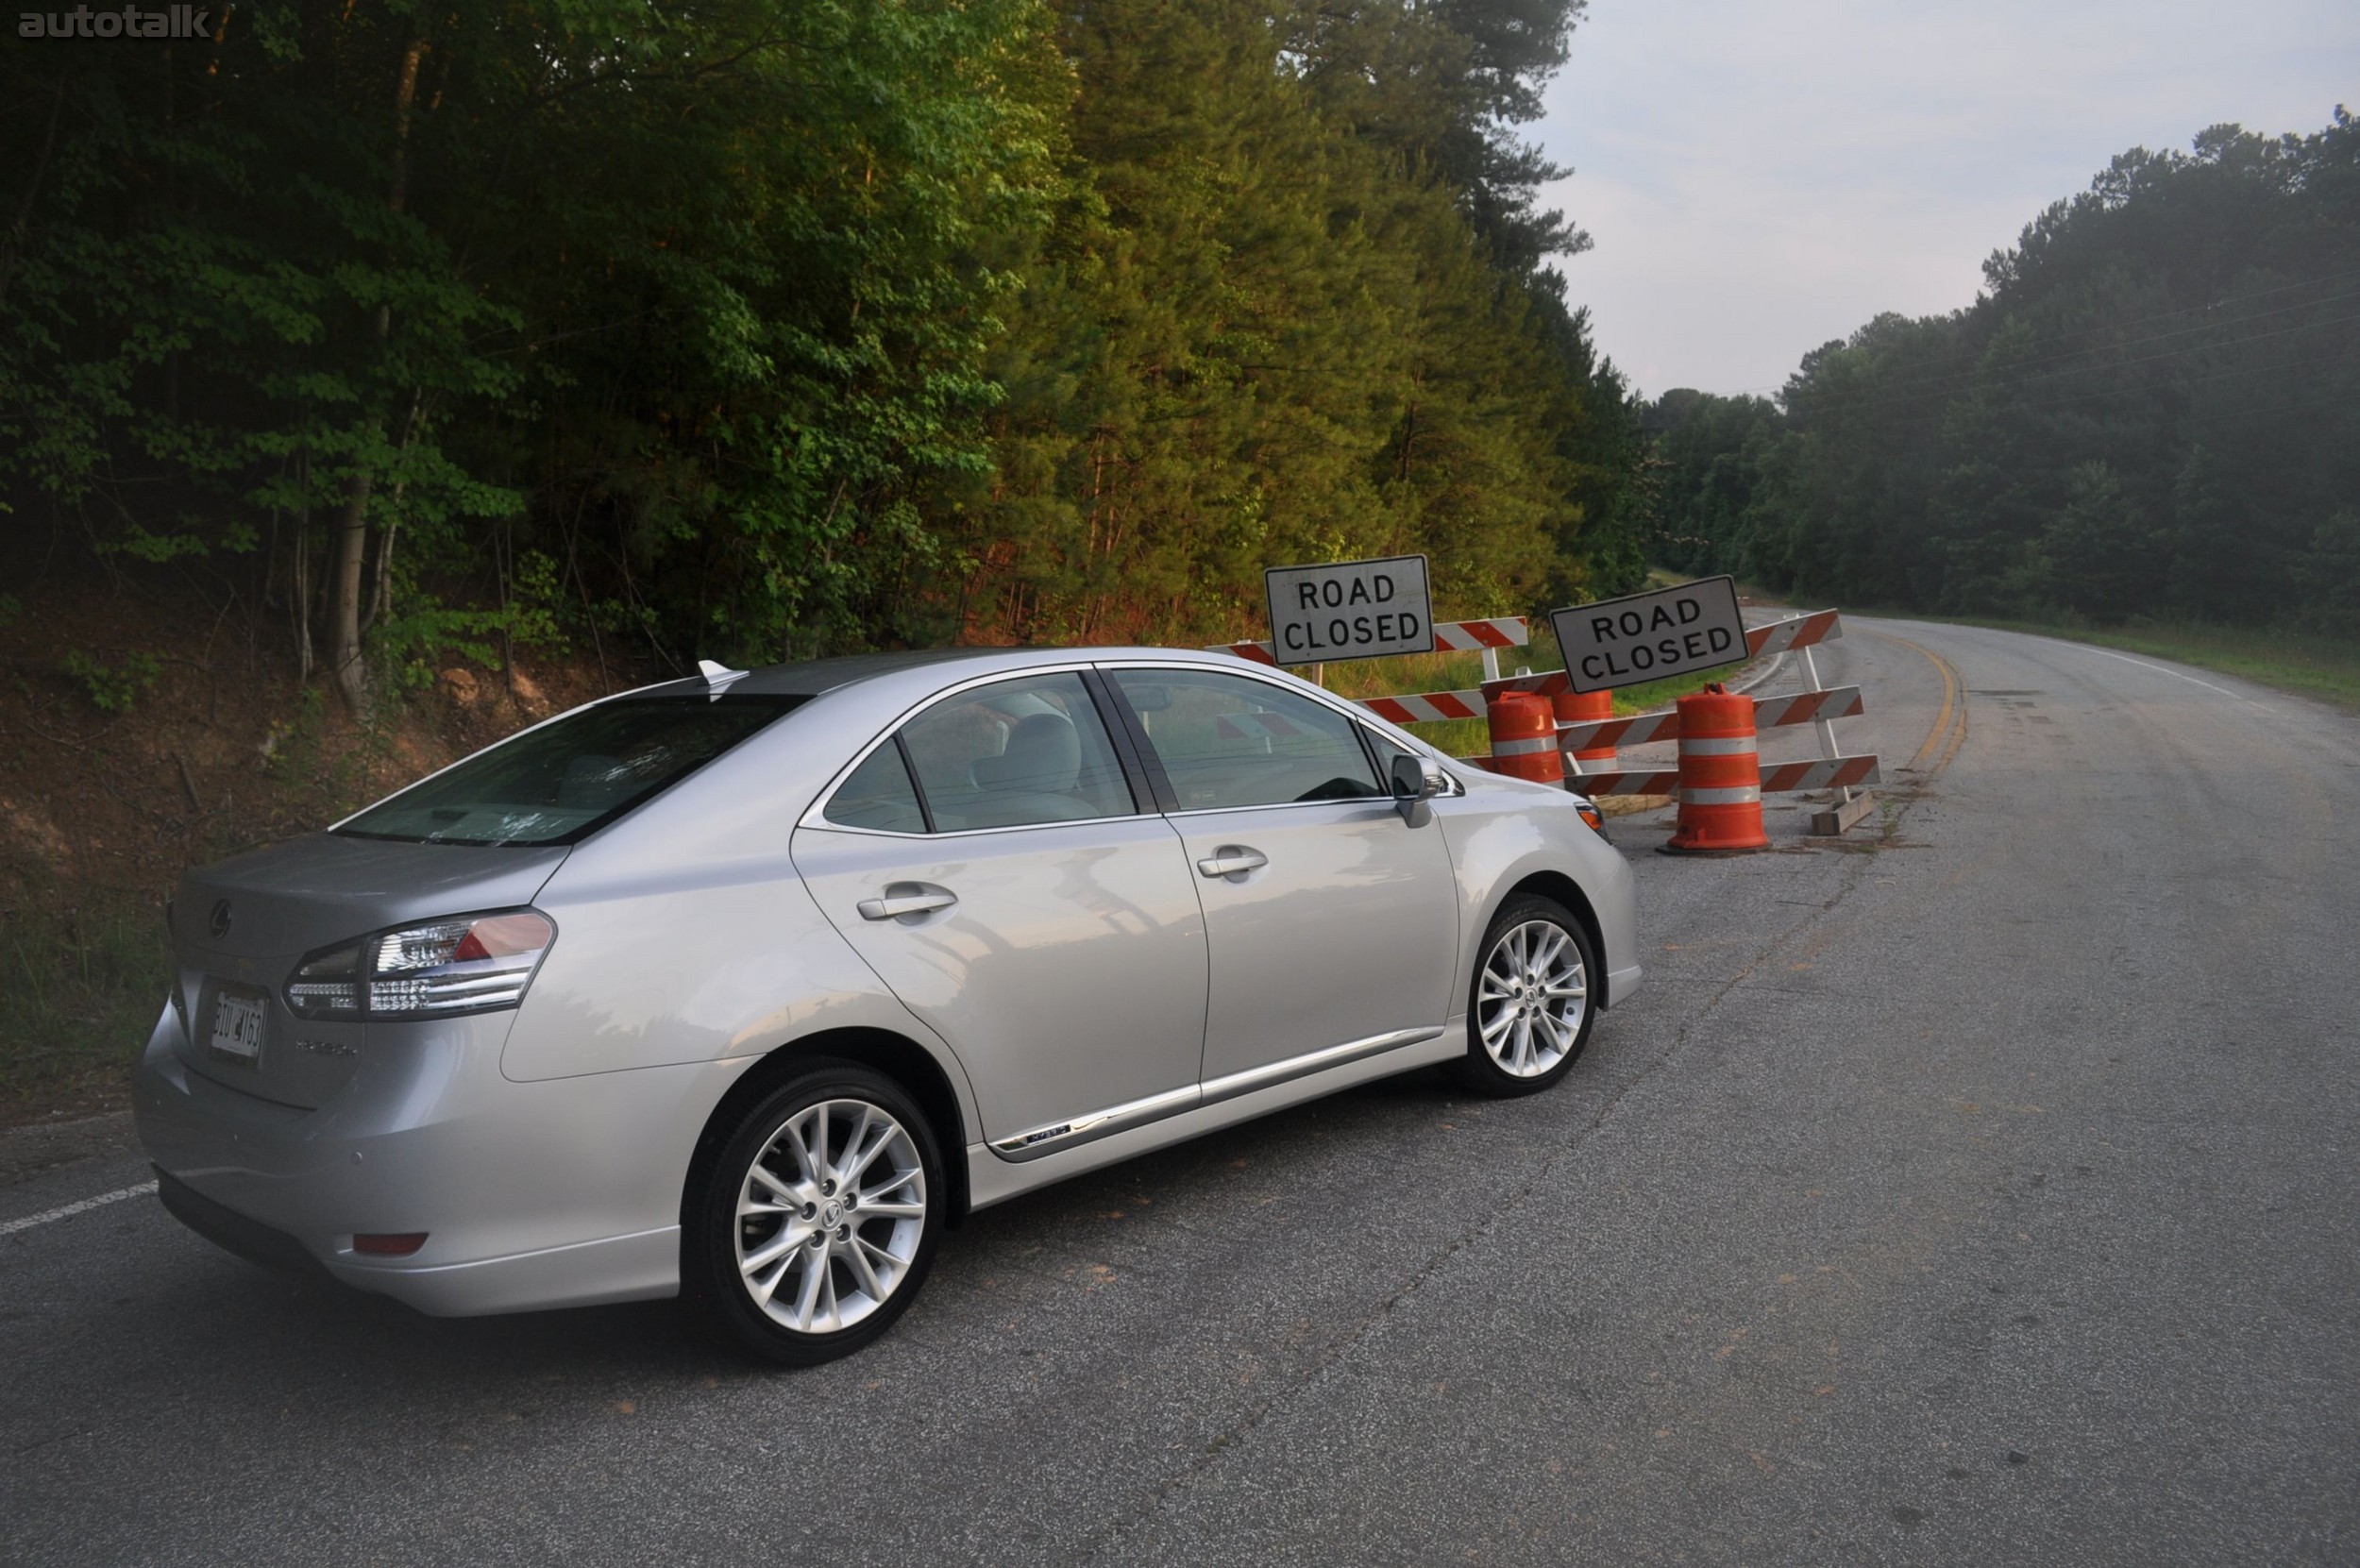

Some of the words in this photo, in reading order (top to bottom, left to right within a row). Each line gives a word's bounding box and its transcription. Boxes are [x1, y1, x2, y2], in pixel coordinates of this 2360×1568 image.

[1299, 575, 1394, 610] ROAD
[1285, 613, 1419, 650] CLOSED
[1592, 599, 1701, 643] ROAD
[1581, 627, 1731, 680] CLOSED
